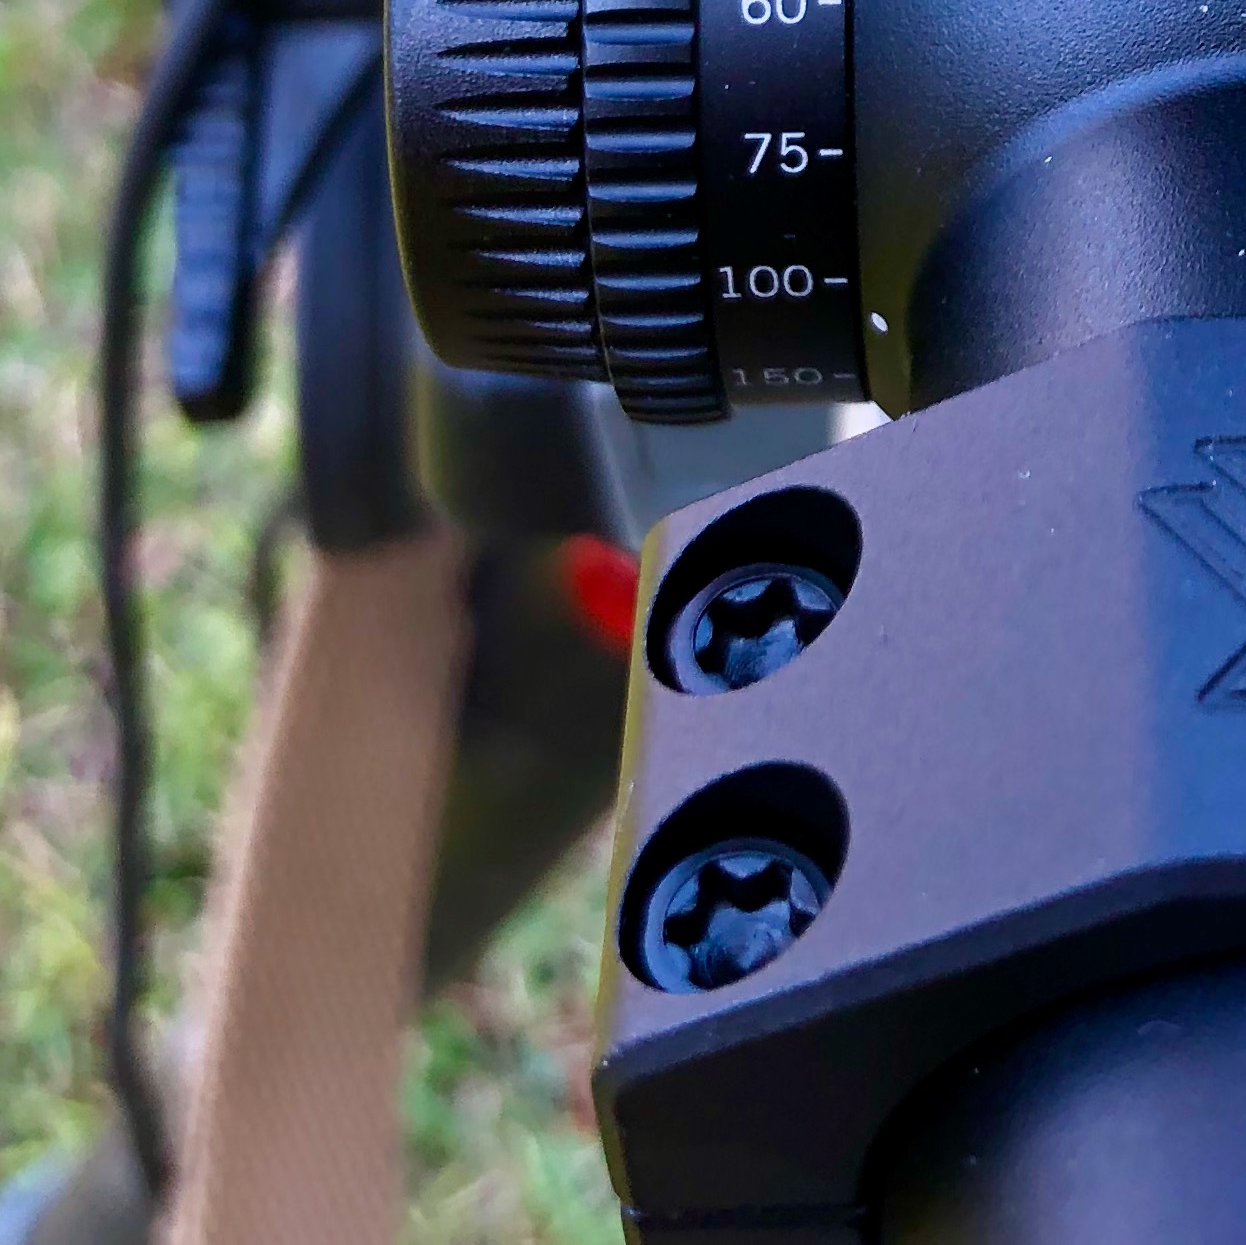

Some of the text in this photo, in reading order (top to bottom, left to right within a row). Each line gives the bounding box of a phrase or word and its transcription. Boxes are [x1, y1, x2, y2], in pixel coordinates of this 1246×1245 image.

[743, 132, 809, 174] 75
[718, 264, 814, 299] 100
[731, 367, 824, 386] 150
